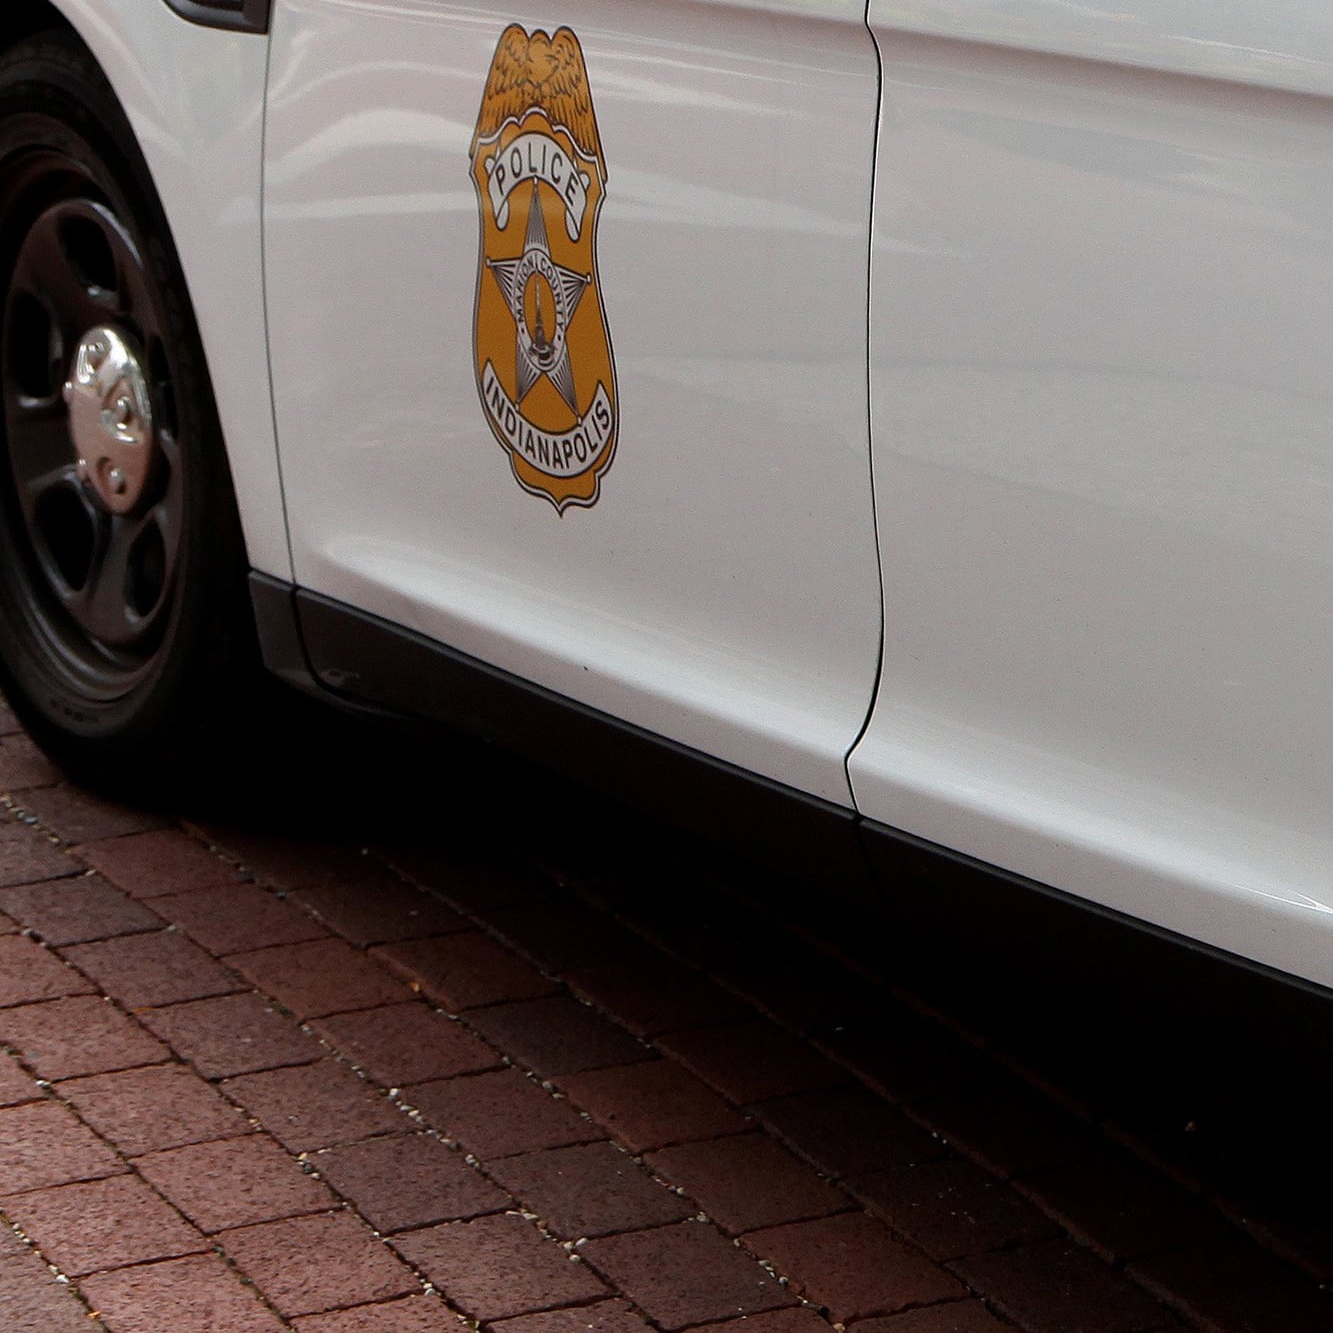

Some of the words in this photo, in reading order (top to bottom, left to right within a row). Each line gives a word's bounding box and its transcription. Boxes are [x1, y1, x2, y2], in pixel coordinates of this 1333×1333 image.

[494, 141, 579, 207] POLICE
[515, 256, 534, 323] MARION
[540, 257, 564, 332] COUNTY
[486, 376, 610, 470] INDIANAPOLIS
